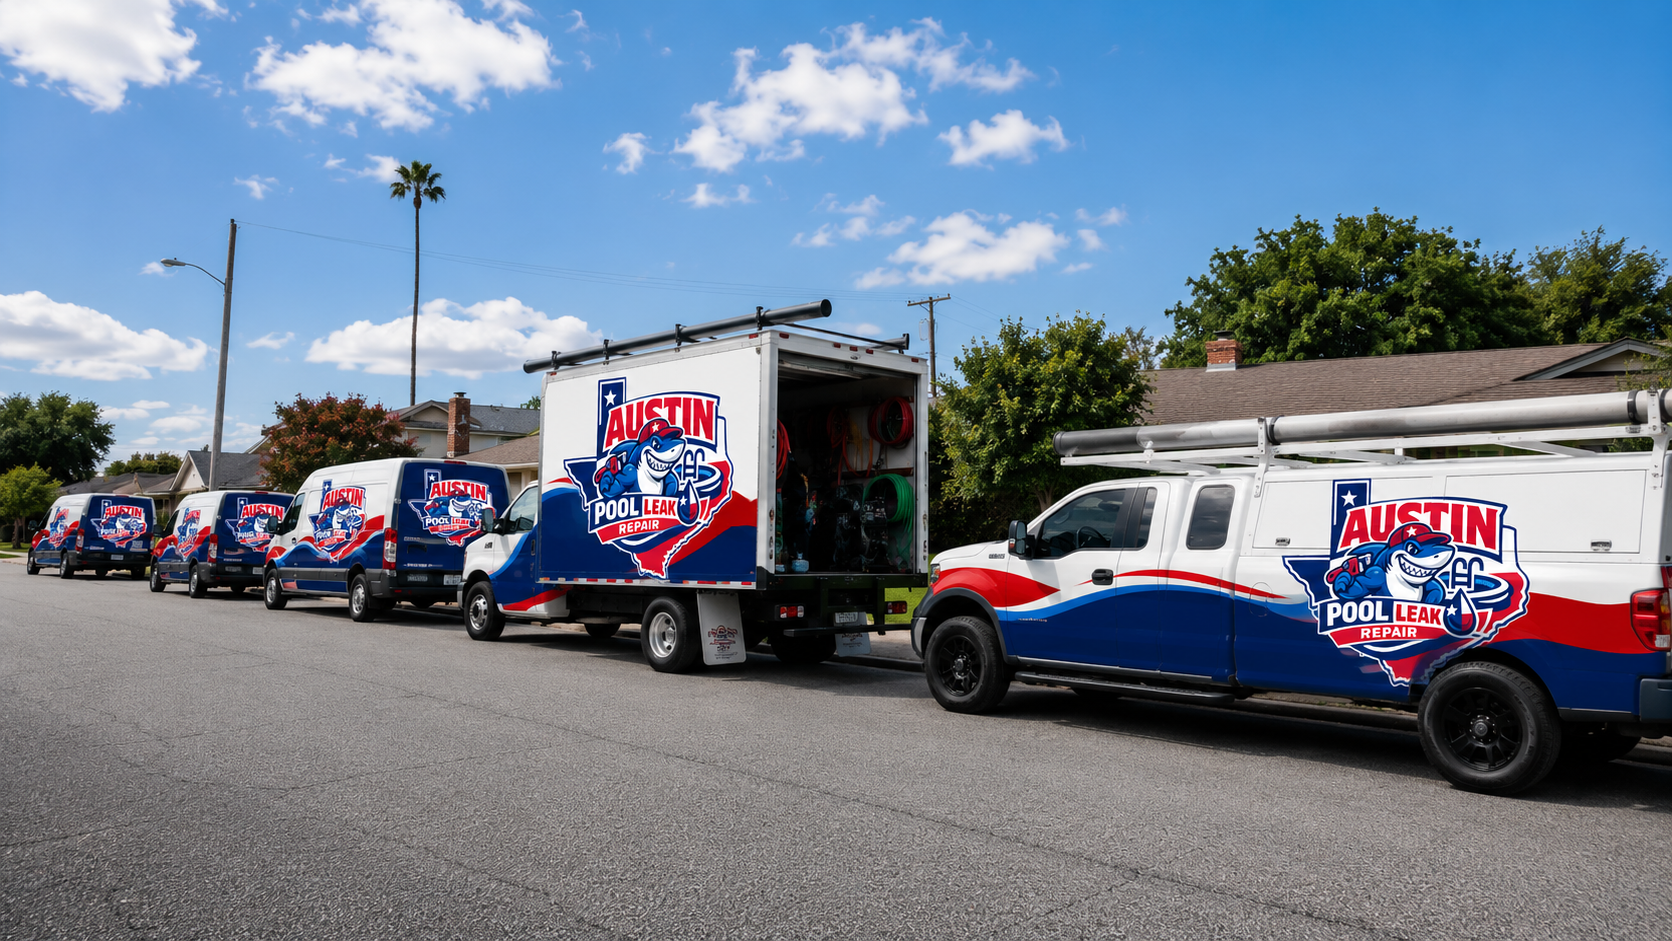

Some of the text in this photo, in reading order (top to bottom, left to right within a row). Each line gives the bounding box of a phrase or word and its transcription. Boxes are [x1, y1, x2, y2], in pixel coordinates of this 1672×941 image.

[605, 397, 715, 449] AUSTIN
[322, 487, 364, 511] AUSTIN
[430, 481, 487, 501] AUSTIN
[595, 497, 676, 525] POOL LEAK
[618, 520, 660, 535] REPAIR
[1340, 502, 1498, 550] AUSTIN
[1327, 602, 1441, 627] POOL LEAK
[1360, 626, 1417, 640] REPAIR
